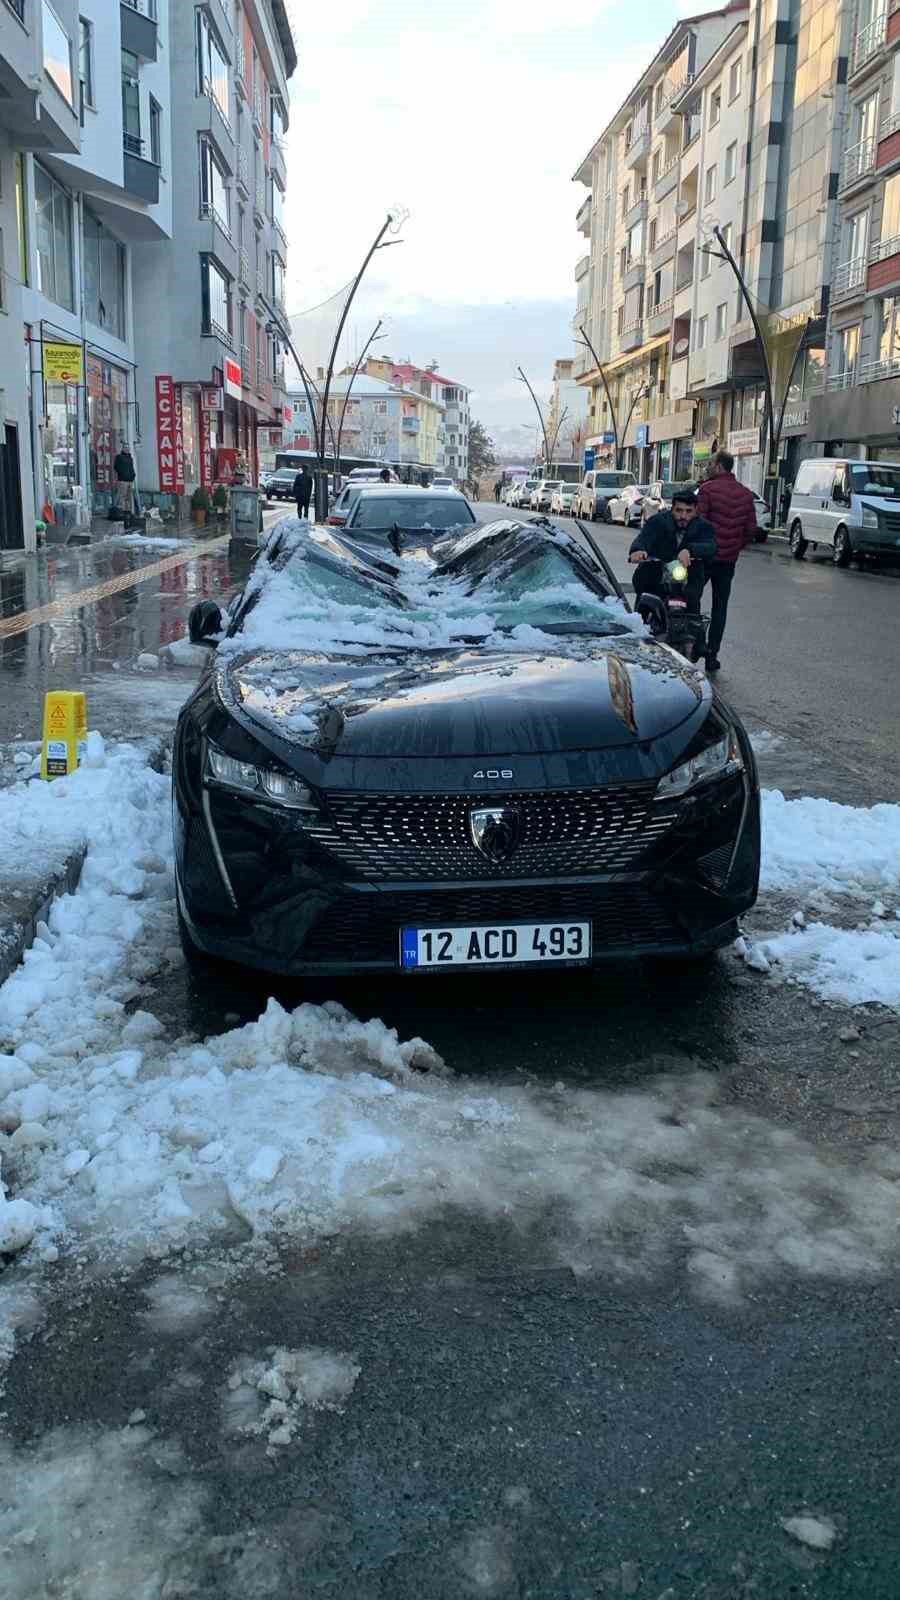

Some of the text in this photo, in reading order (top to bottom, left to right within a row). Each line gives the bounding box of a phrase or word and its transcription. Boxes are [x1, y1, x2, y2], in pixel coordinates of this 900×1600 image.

[208, 393, 217, 406] E
[159, 380, 173, 485] ECZANE
[175, 387, 184, 478] ECZANE
[203, 412, 212, 479] CZANE
[473, 770, 513, 778] 408
[404, 926, 583, 961] TR 12 ACD 493
